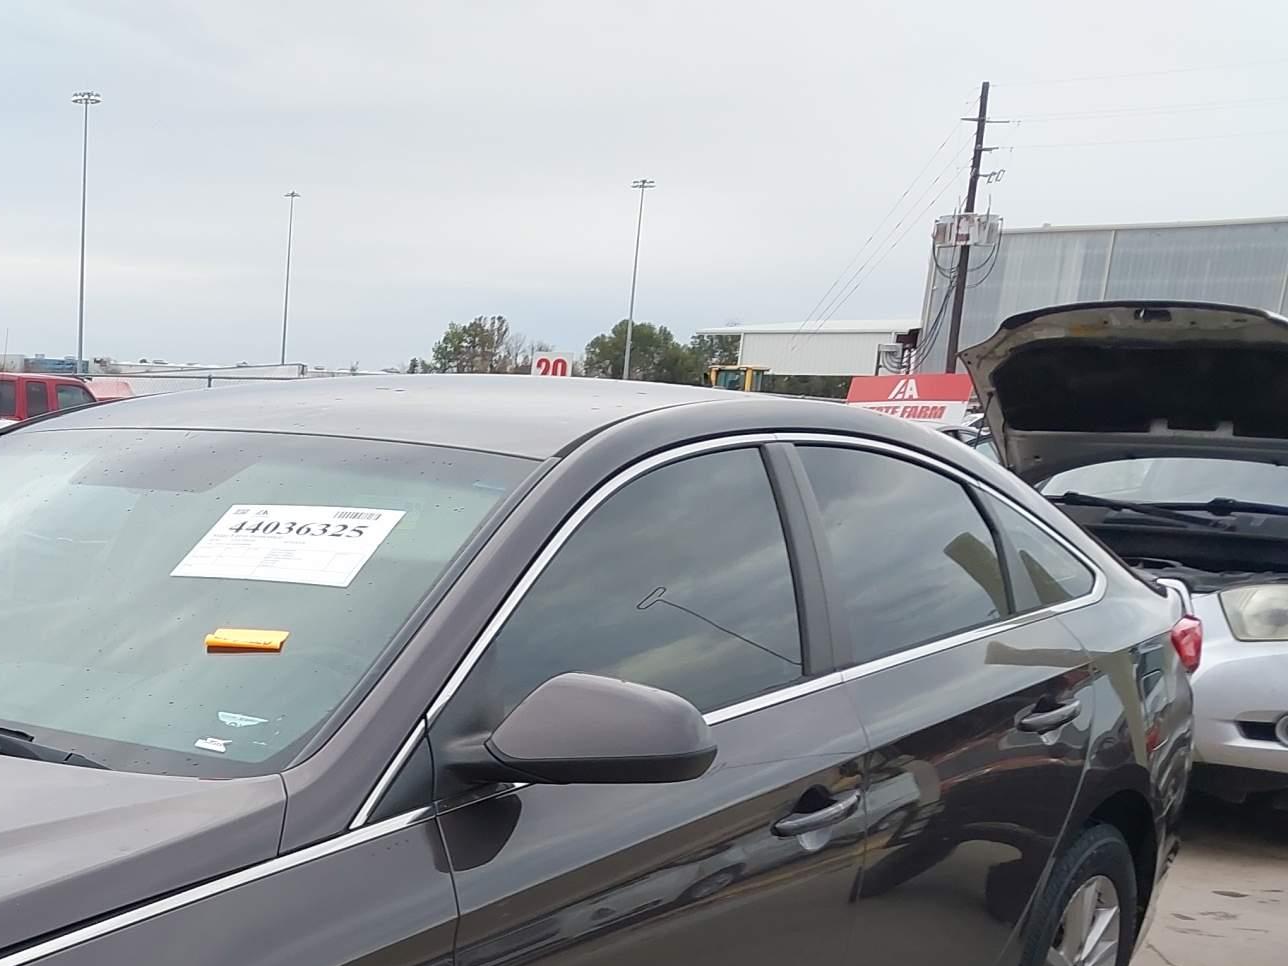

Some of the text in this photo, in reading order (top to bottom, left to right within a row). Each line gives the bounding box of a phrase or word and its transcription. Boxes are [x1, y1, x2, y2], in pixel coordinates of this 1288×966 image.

[536, 357, 568, 377] 20
[900, 405, 946, 418] FARM
[229, 520, 369, 539] 44036325
